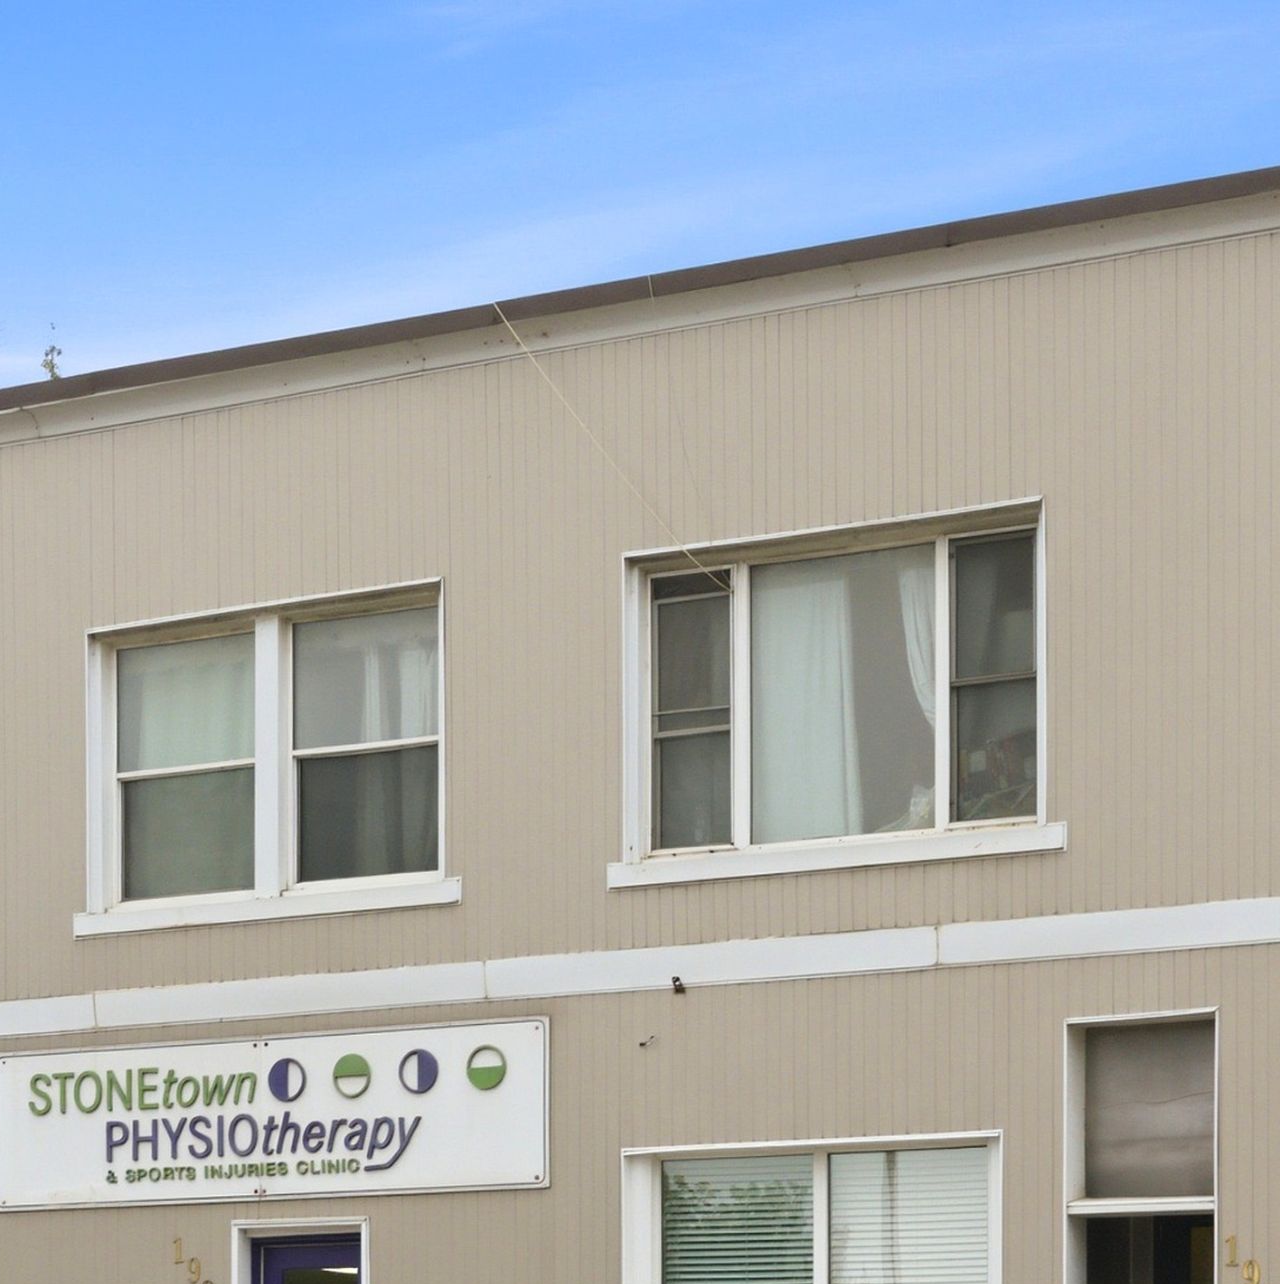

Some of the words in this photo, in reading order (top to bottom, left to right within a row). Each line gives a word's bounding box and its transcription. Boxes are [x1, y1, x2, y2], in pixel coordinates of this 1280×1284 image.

[28, 1067, 258, 1117] STONEtown
[105, 1110, 422, 1172] PHYSIOtherapy
[105, 1169, 118, 1184] &
[125, 1165, 197, 1184] SPORTS
[204, 1161, 289, 1180] INJURIES
[296, 1157, 361, 1176] CLINIC
